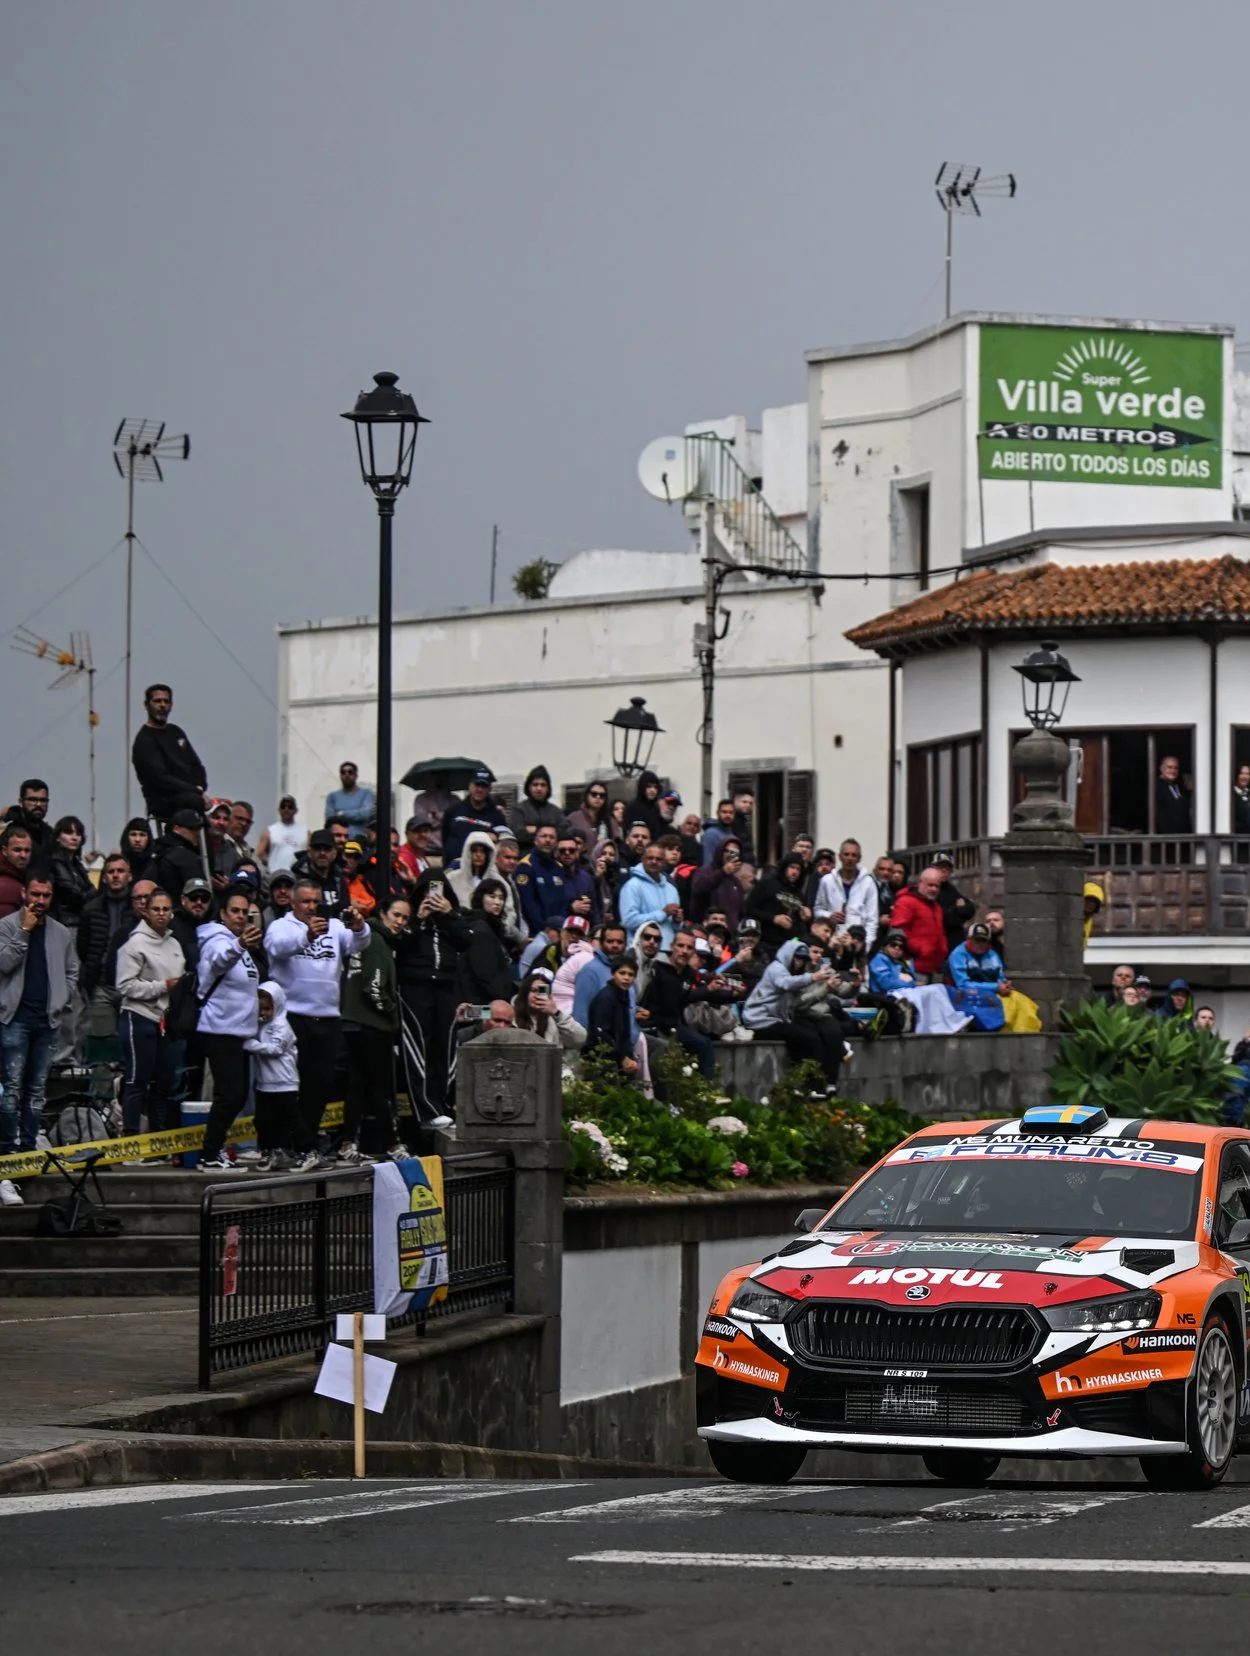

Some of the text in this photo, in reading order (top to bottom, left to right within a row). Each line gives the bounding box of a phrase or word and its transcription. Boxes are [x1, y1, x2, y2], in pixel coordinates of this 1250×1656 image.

[1081, 372, 1122, 387] Super
[997, 379, 1205, 419] Villa verde
[988, 424, 1176, 444] A 50 METROS
[991, 451, 1210, 478] ABIERTO TODOS LOS DÍAS
[150, 1135, 173, 1153] ZONA
[949, 1135, 1155, 1150] MS MUNARETTO
[951, 1144, 1179, 1166] FORUM8
[848, 1267, 1005, 1289] MOTUL
[729, 1360, 780, 1384] HYRMASKINER
[910, 1371, 924, 1379] 109
[1085, 1368, 1163, 1389] HYRMASKINER
